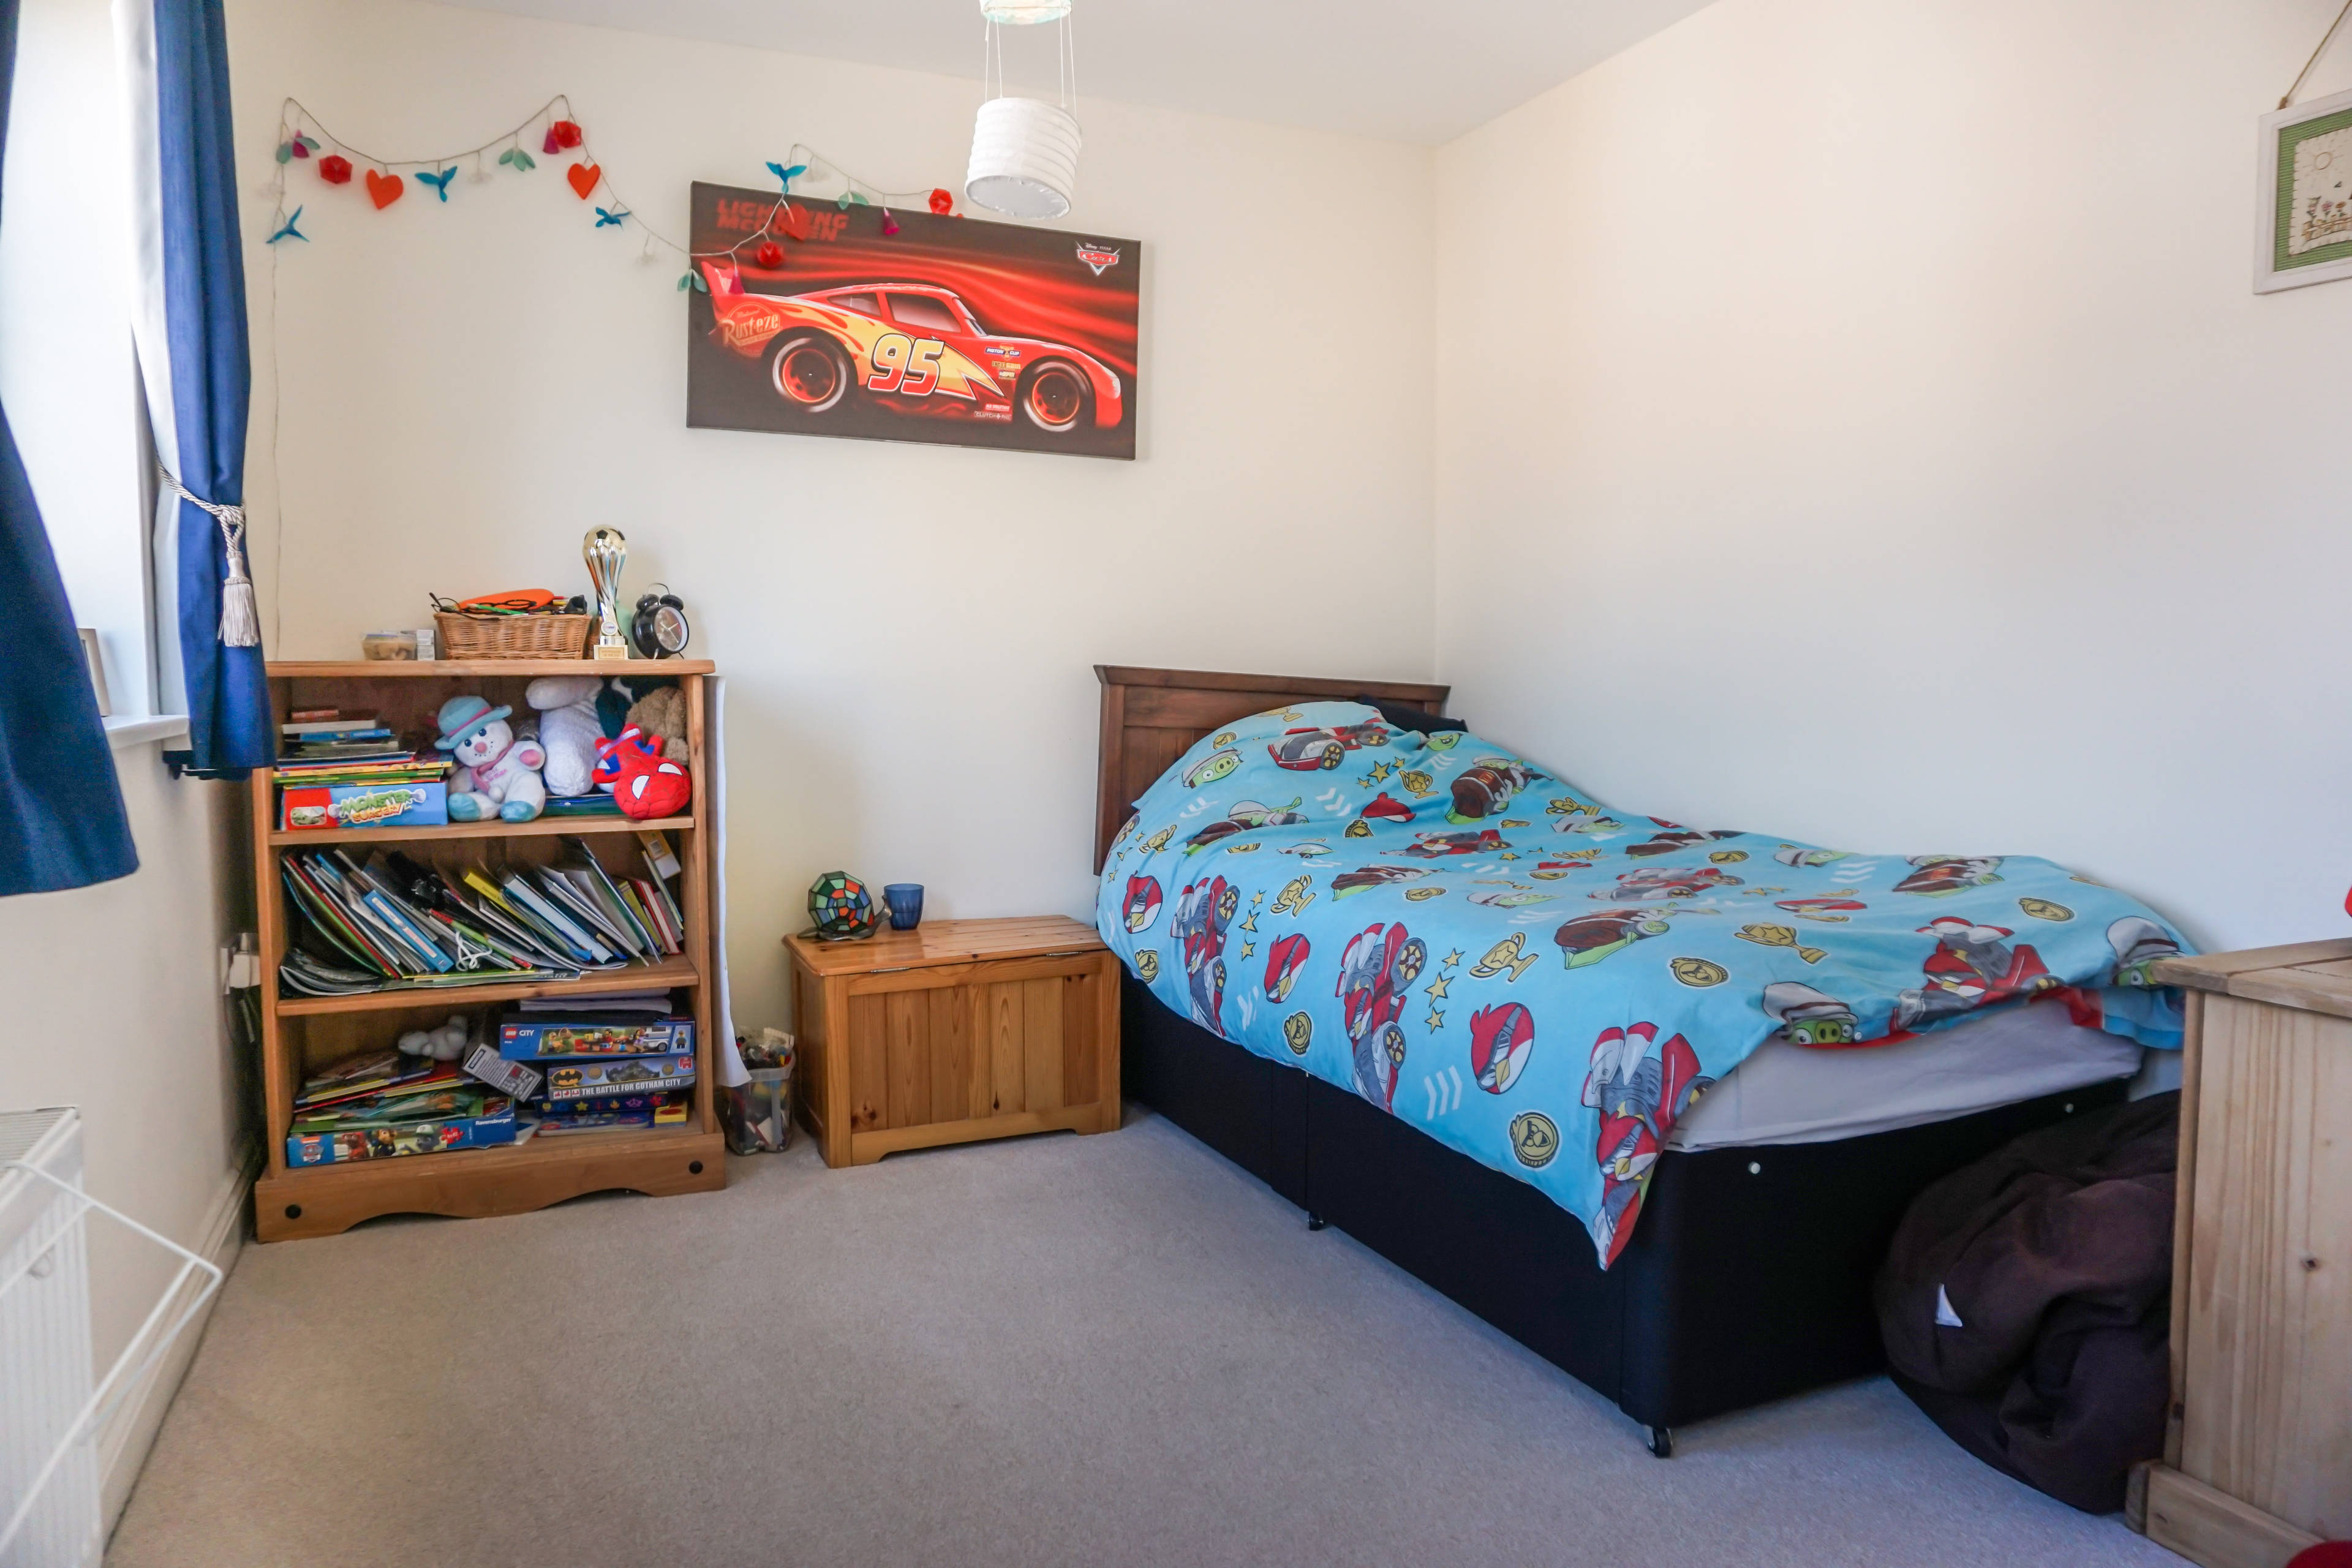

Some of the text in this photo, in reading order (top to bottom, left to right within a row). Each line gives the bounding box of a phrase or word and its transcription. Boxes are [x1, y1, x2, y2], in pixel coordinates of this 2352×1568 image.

[1082, 252, 1112, 262] Cars
[867, 333, 944, 396] 95
[342, 790, 412, 816] MONSTER
[352, 802, 402, 822] SURGERY
[596, 1085, 619, 1094] BATTLE
[621, 1083, 634, 1091] FOR
[635, 1080, 664, 1090] GOTHAM
[665, 1078, 681, 1087] CITY
